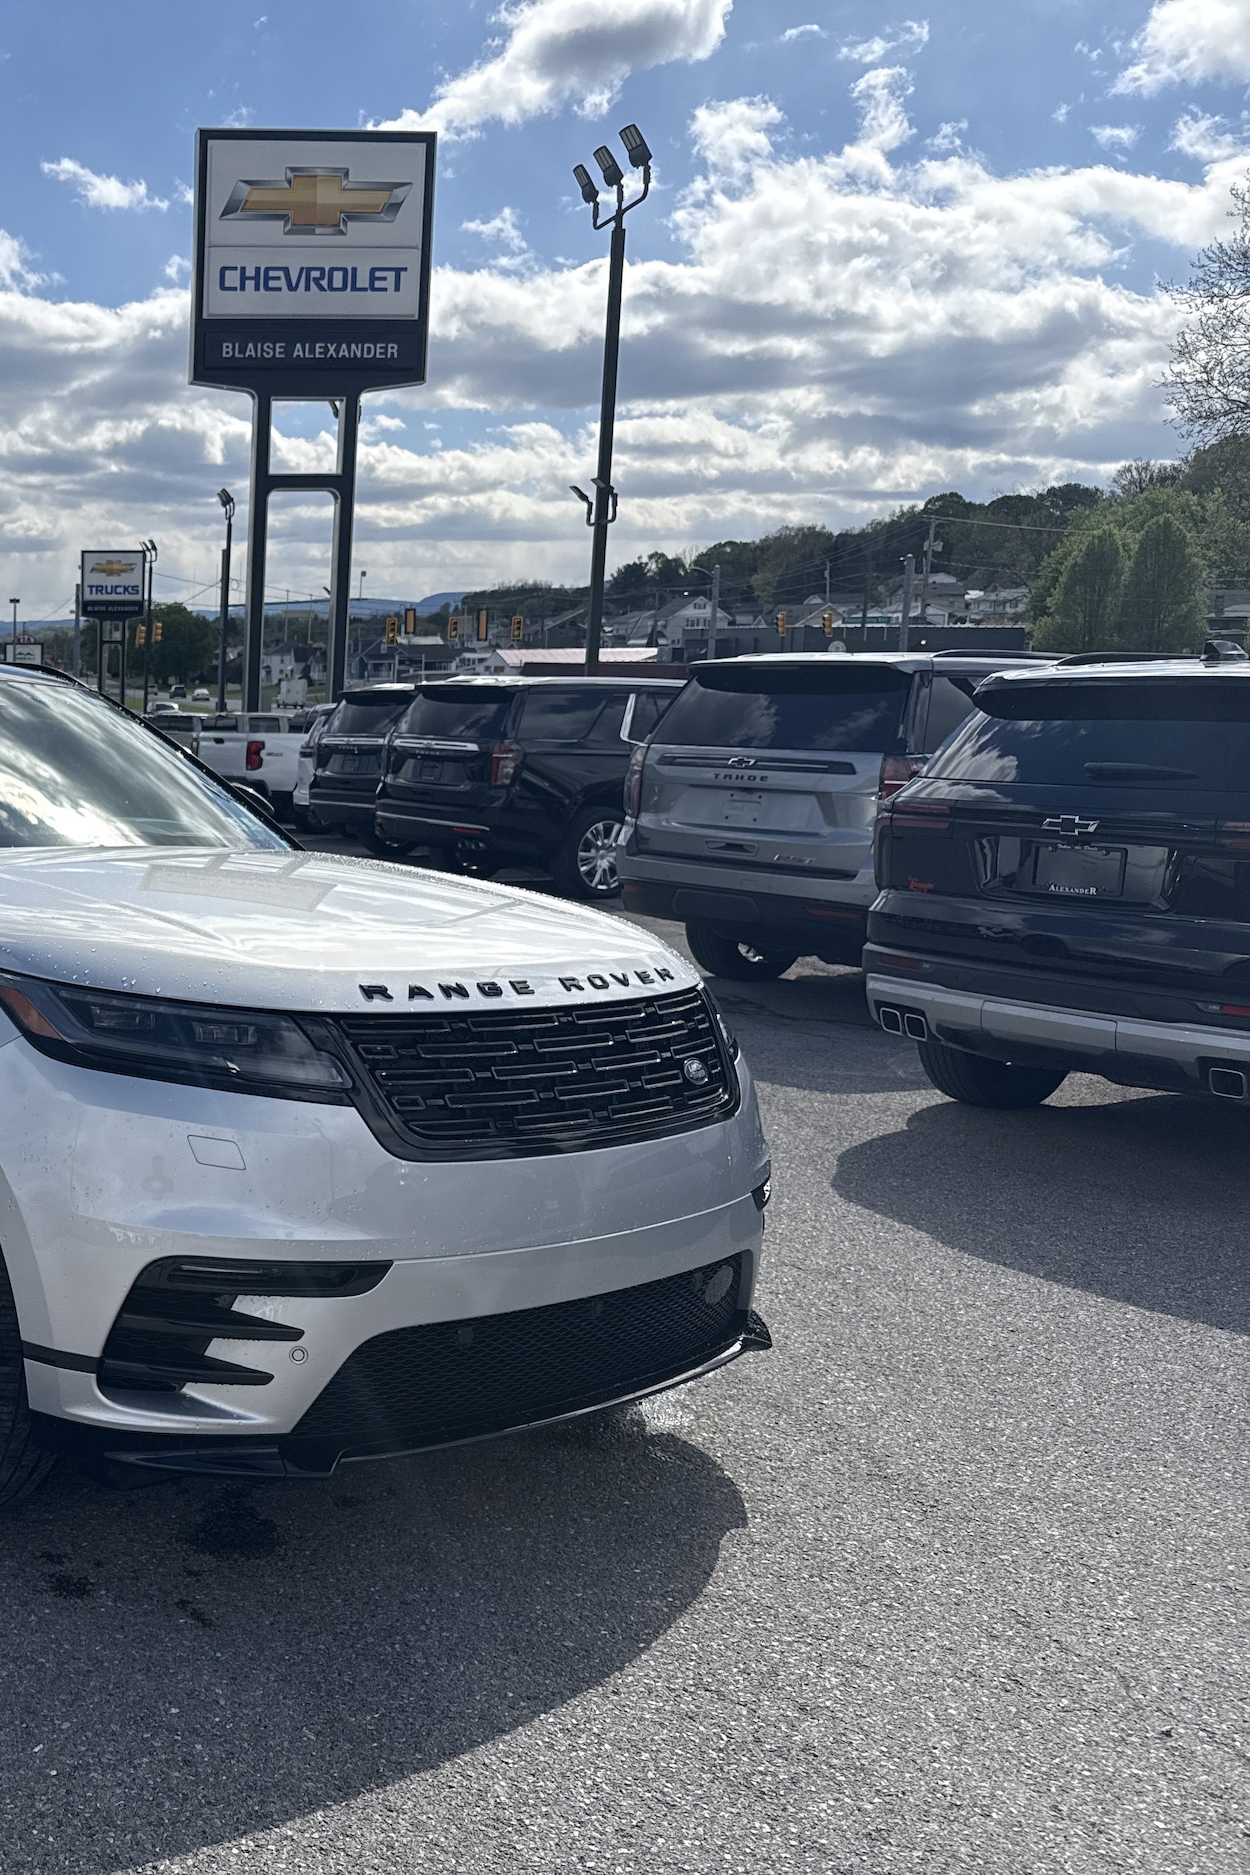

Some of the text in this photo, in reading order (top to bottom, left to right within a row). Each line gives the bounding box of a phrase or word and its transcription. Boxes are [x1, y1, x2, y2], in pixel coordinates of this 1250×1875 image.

[219, 266, 408, 292] CHEVROLET
[222, 342, 398, 359] BLAISE ALEXANDER
[87, 585, 139, 595] TRUCKS
[713, 773, 769, 782] TAHOE
[359, 967, 675, 1001] RANGE ROVER
